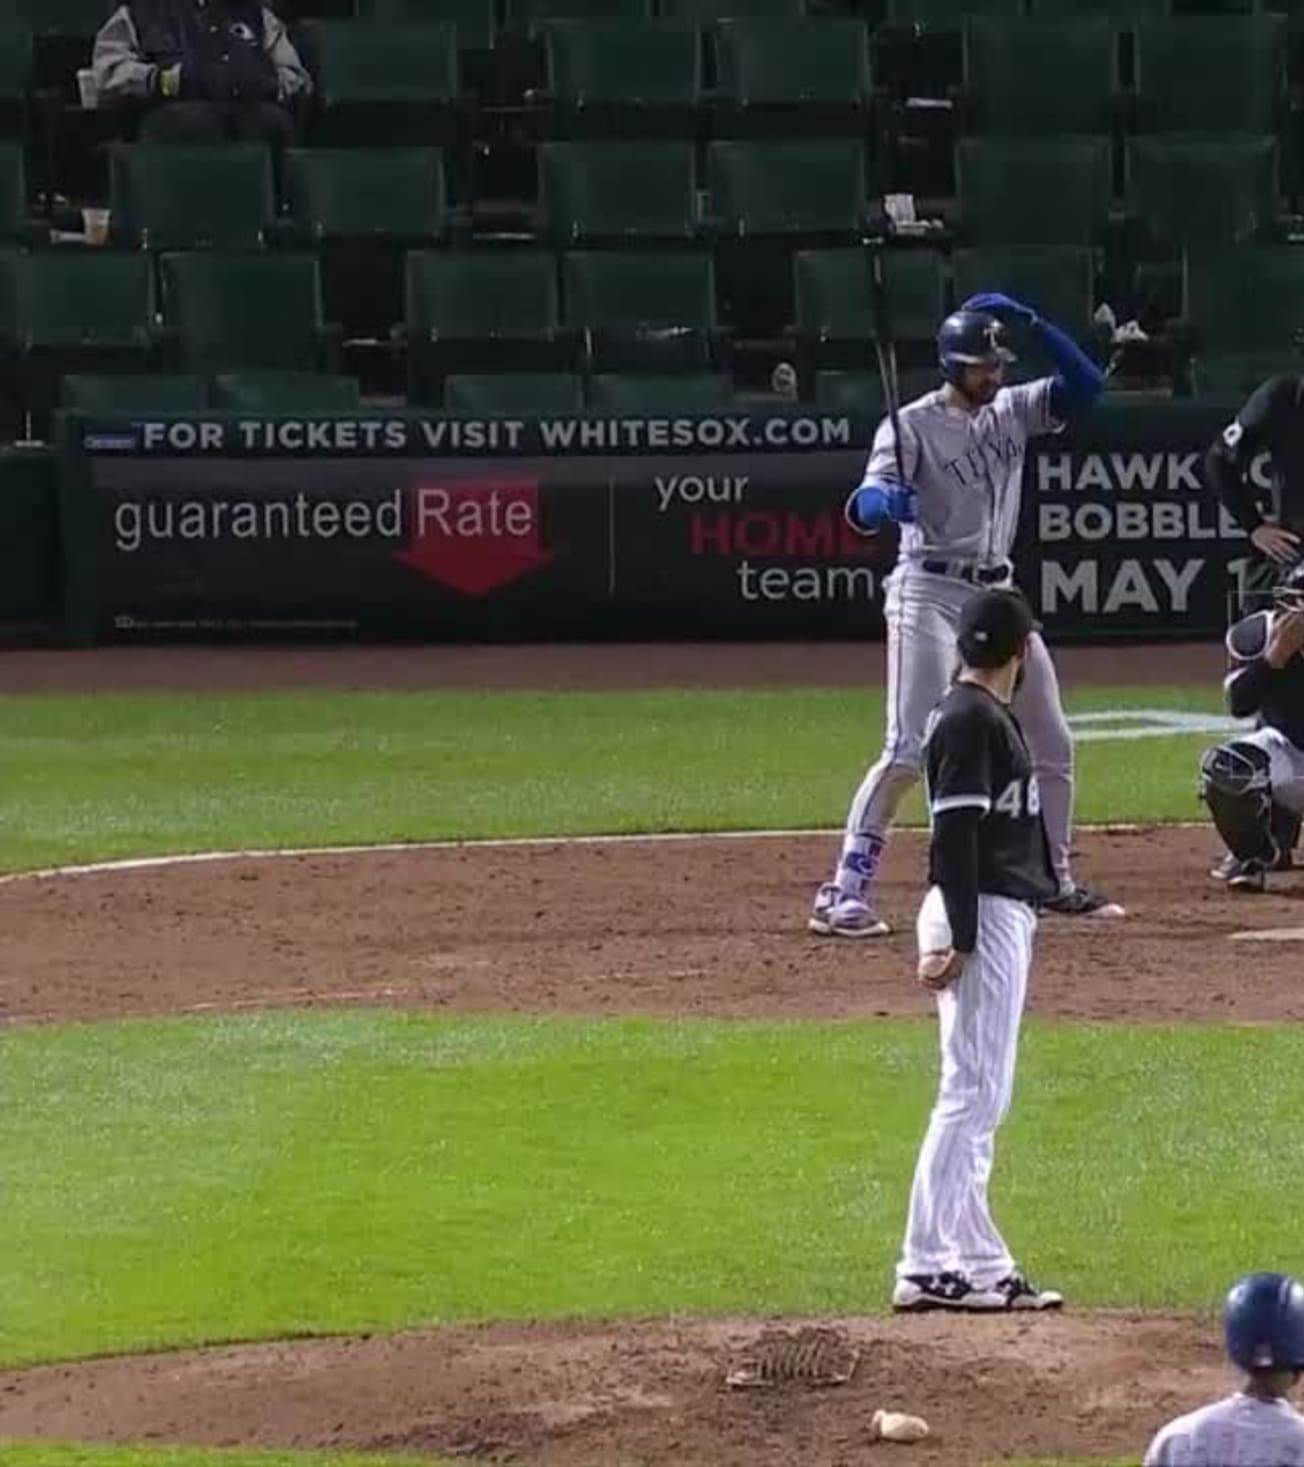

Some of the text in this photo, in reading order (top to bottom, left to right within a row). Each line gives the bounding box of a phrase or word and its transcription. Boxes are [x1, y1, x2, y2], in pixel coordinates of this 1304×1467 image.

[143, 422, 224, 448] FOR
[239, 420, 407, 449] TICKETS
[422, 420, 526, 448] VISIT
[539, 418, 851, 448] WHITESOX.COM
[654, 475, 749, 512] your
[114, 487, 533, 551] guaranteed Rate
[736, 560, 875, 600] team
[1041, 558, 1205, 613] MAY
